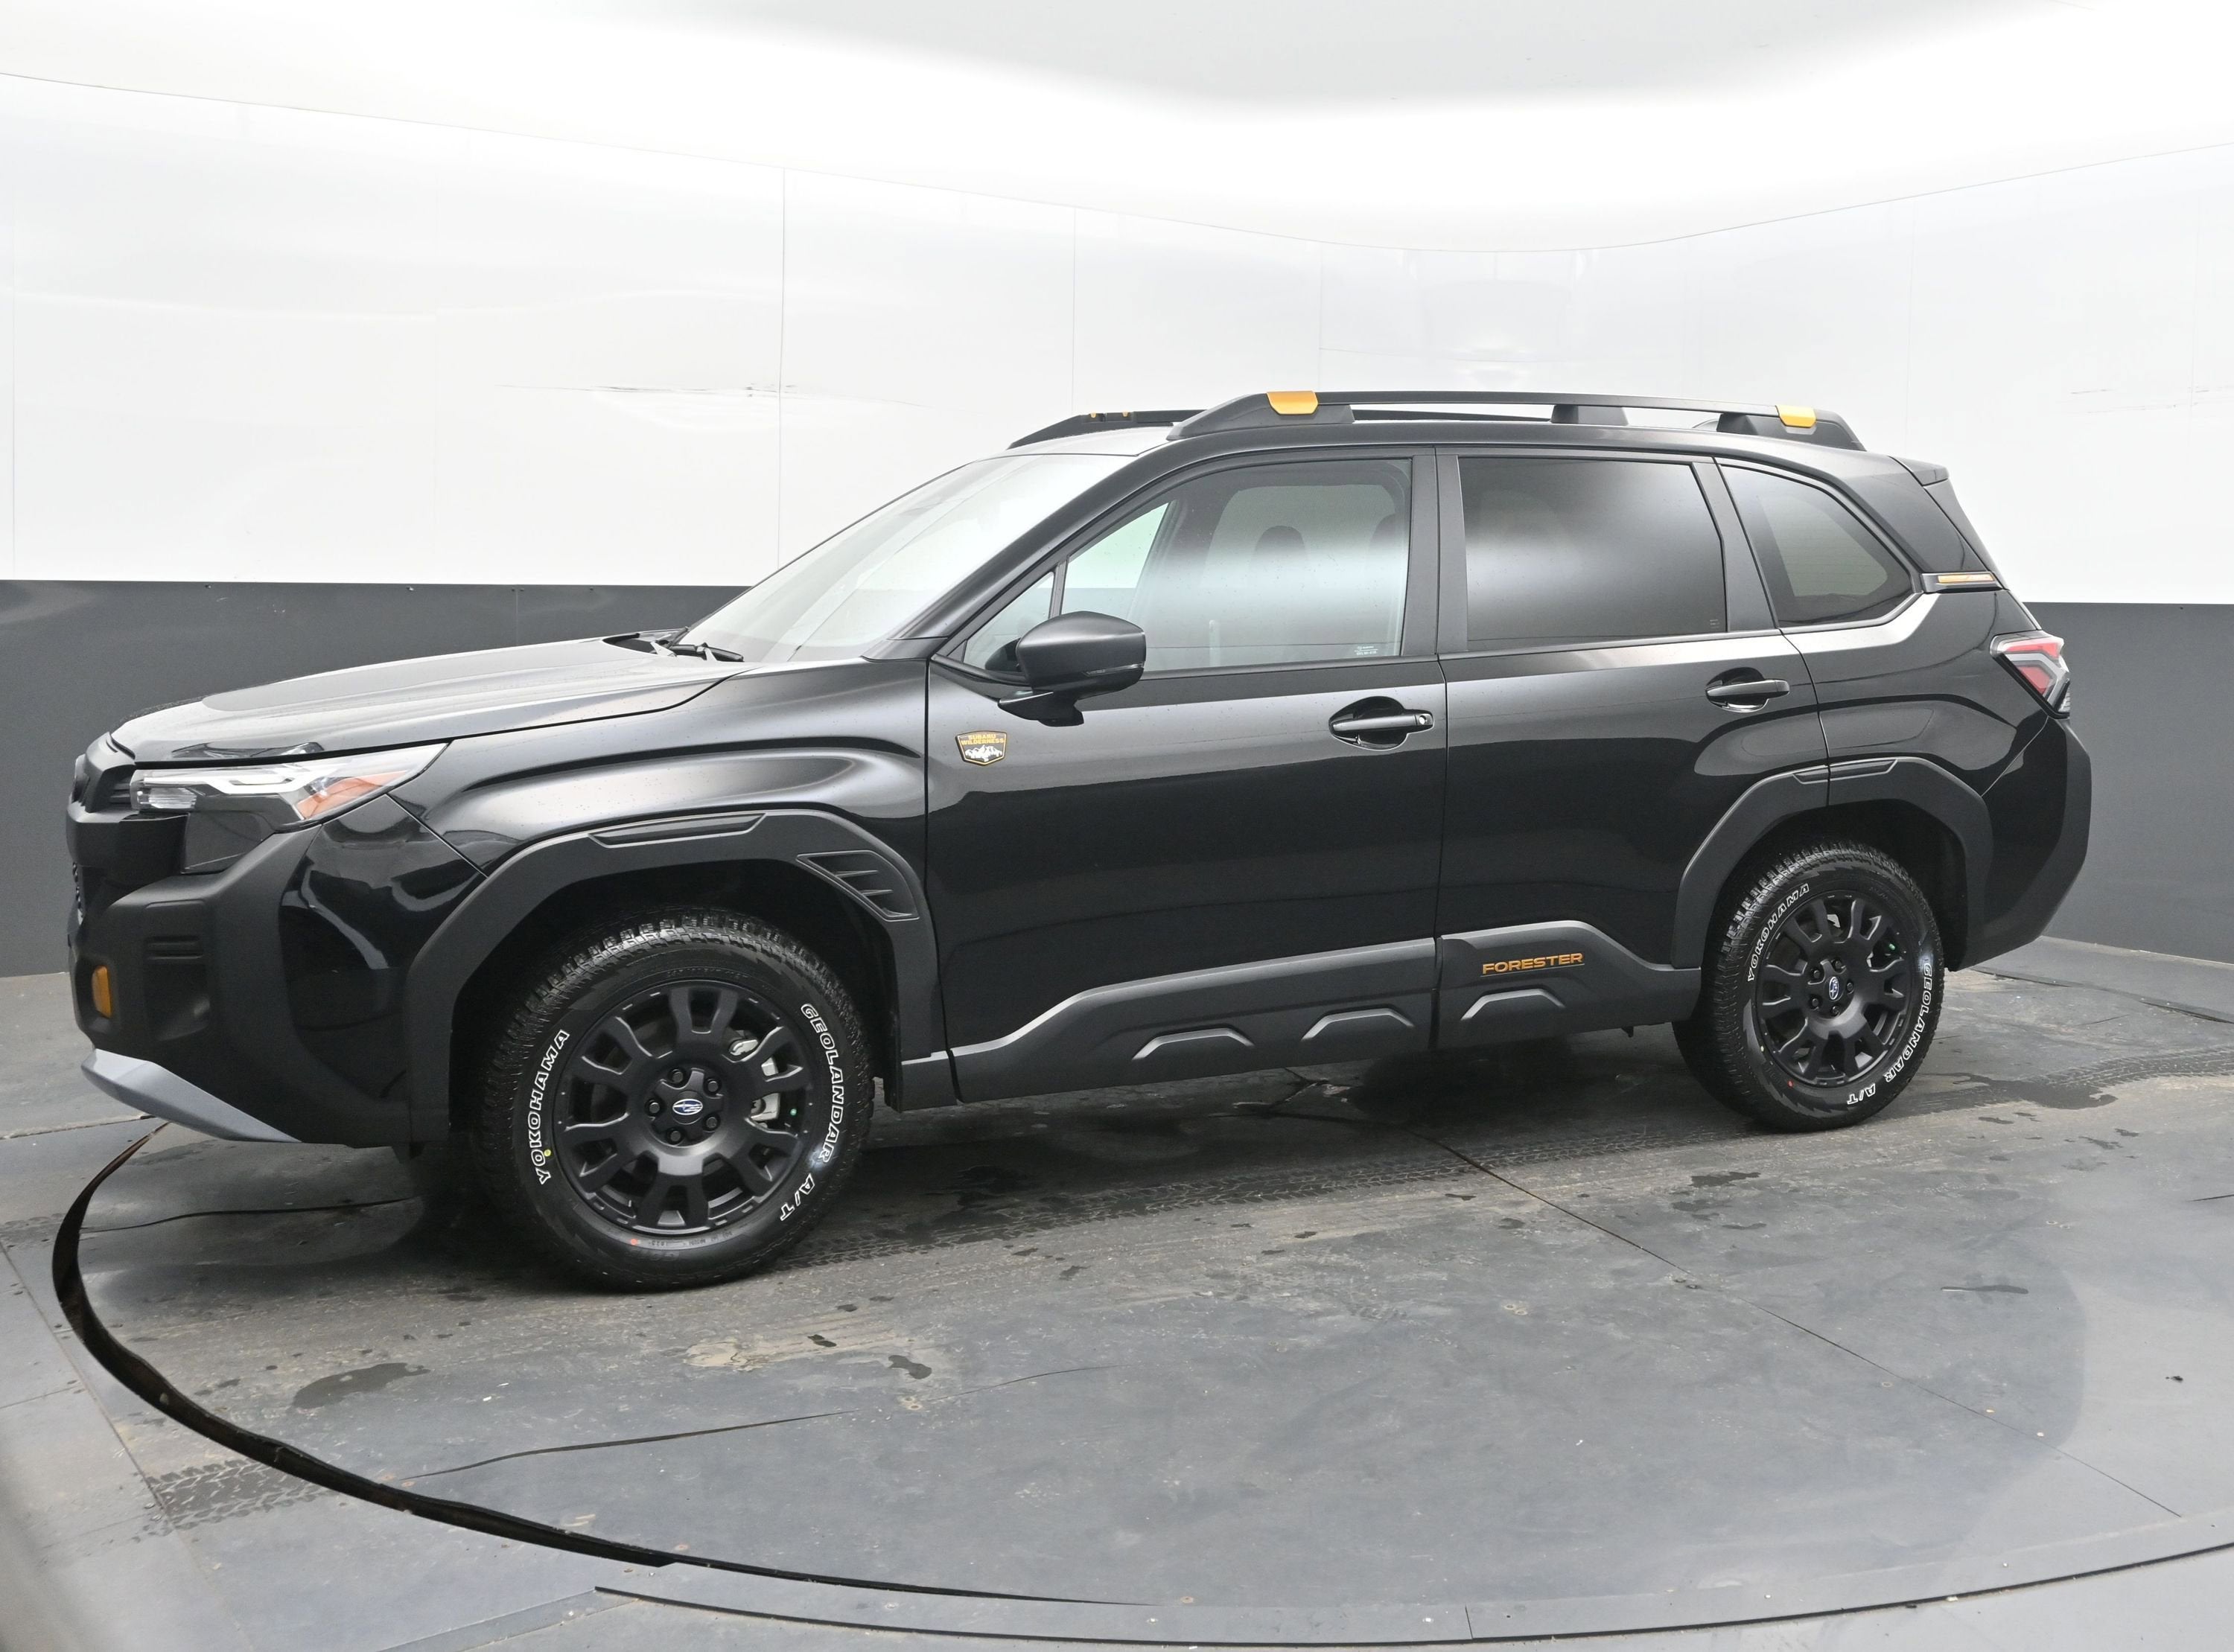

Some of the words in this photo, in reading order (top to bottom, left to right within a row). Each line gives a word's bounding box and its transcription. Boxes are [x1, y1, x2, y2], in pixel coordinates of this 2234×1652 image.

[1483, 953, 1583, 974] FORESTER
[1748, 884, 1809, 981] YOKOHAMA
[1884, 963, 1932, 1082] GEOLANDAR
[527, 1030, 570, 1184] YOKOHAMA
[801, 1004, 844, 1163] GEOLANDAR
[1847, 1083, 1875, 1105] A/T
[780, 1173, 815, 1221] A/T
